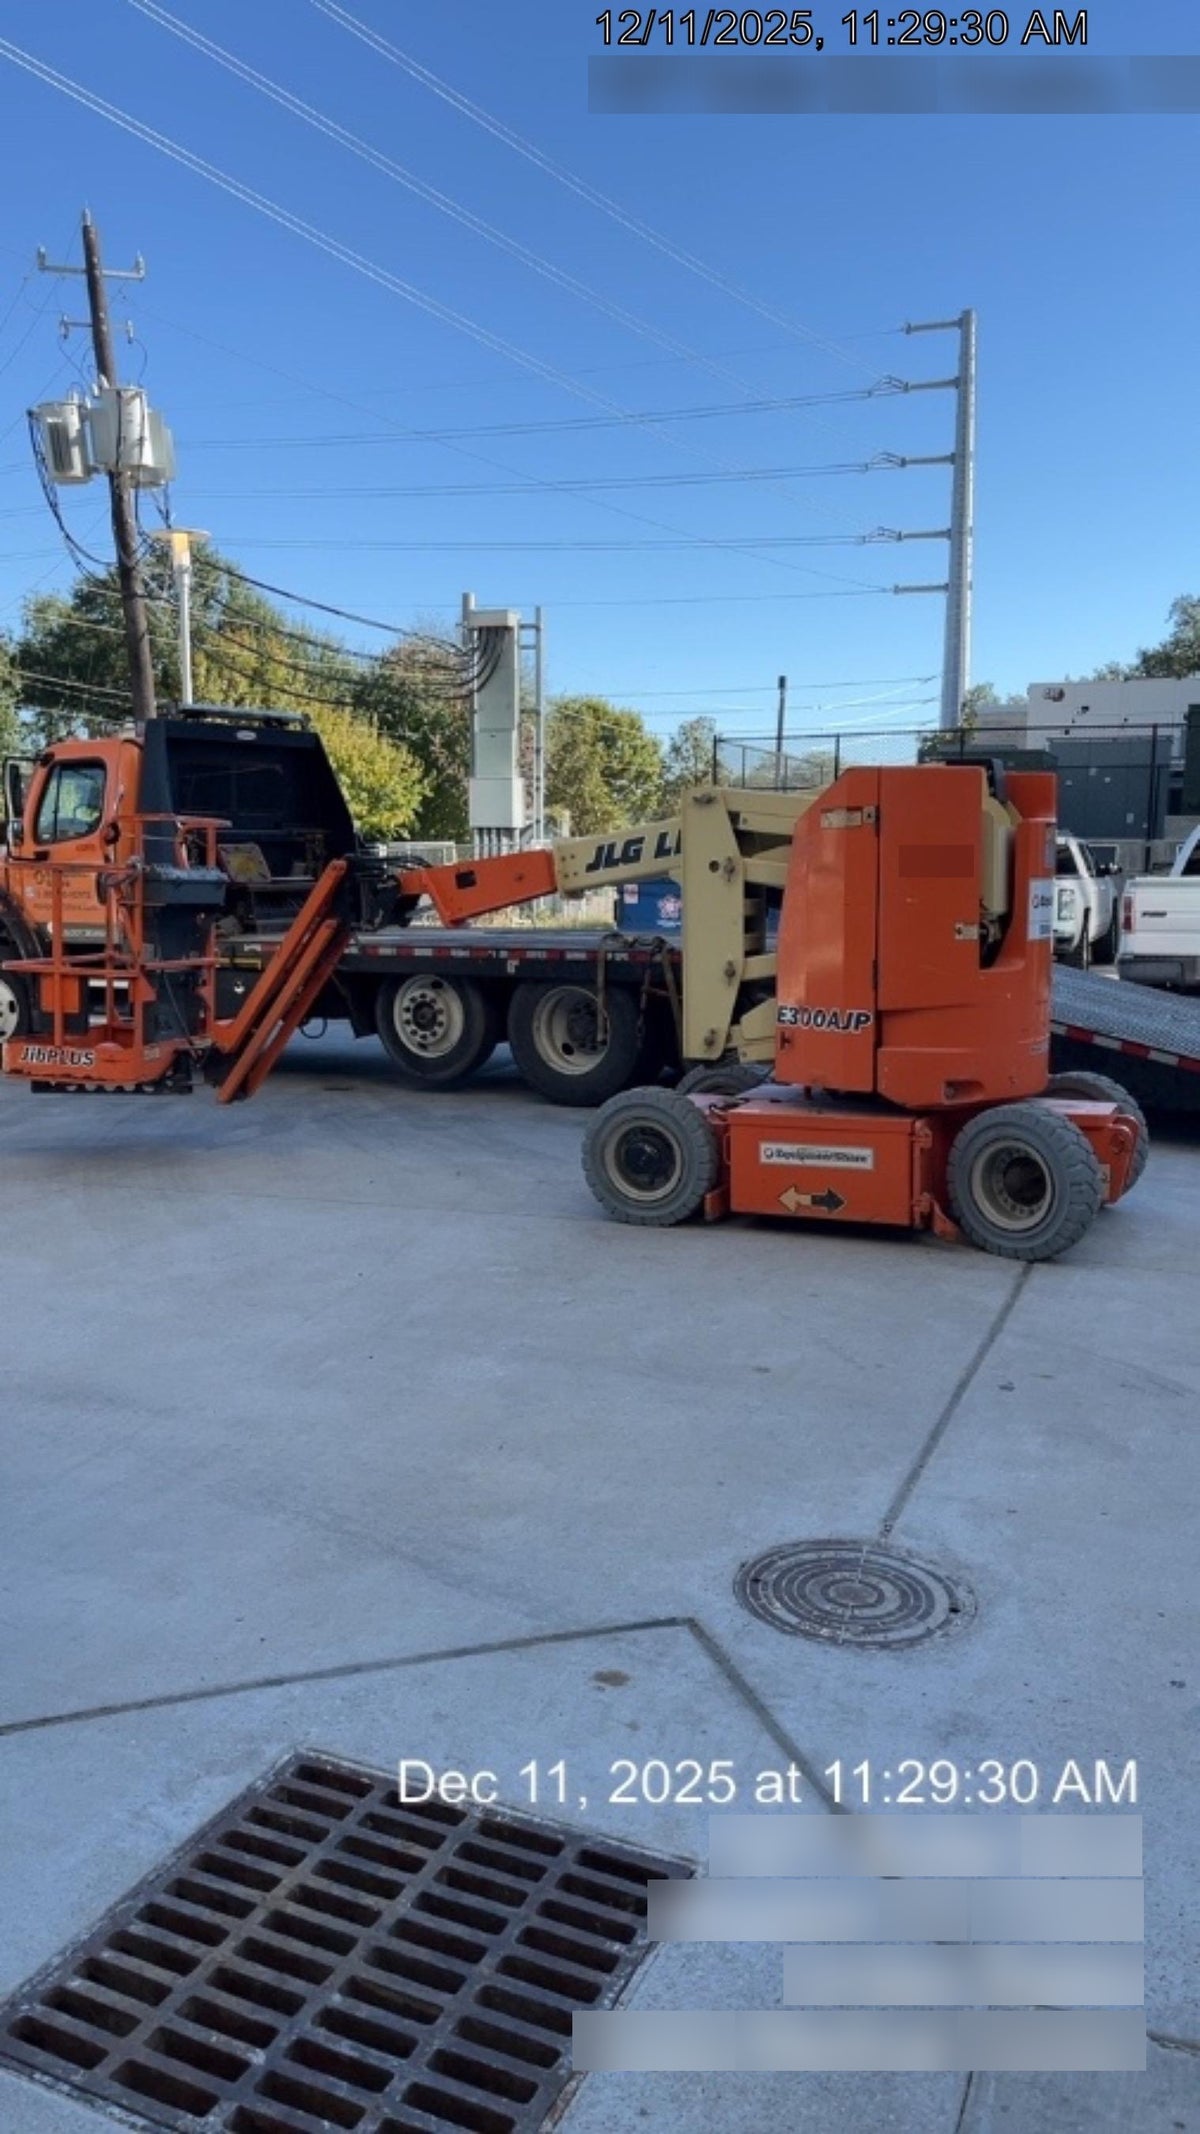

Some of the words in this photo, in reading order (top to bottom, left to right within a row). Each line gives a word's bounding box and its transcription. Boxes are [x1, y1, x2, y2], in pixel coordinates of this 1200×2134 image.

[585, 835, 647, 874] JLG
[776, 1004, 872, 1034] E300AJP
[20, 1046, 95, 1067] JibPLUS
